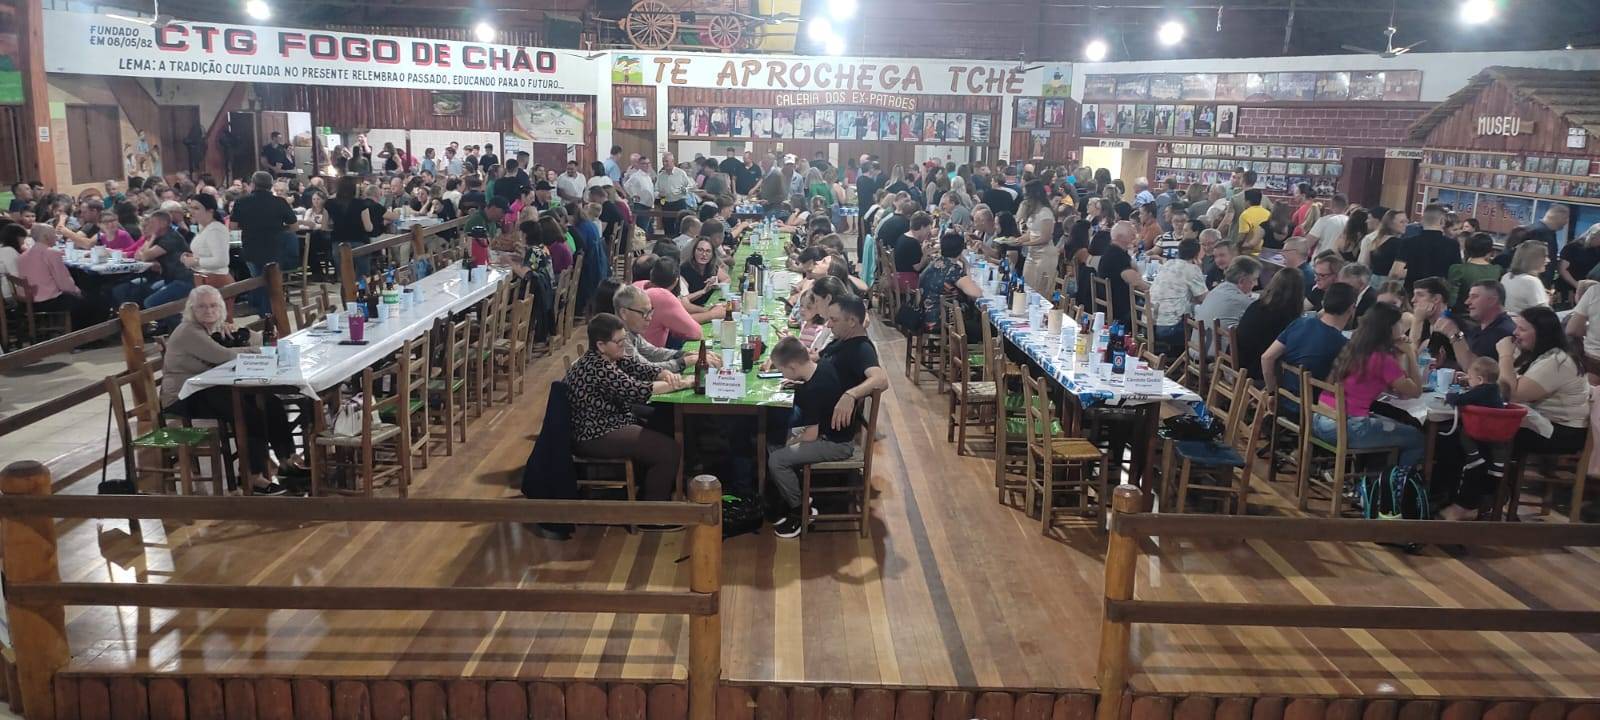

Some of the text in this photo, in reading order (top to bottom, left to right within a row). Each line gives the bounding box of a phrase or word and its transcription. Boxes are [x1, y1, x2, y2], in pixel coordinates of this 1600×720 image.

[90, 25, 139, 37] FUNDADO
[90, 35, 153, 49] EM 08/05/82
[154, 24, 557, 74] CTG FOGO DE CHÃO
[118, 58, 156, 71] LEMA:
[159, 60, 167, 71] A
[171, 59, 222, 75] TRADIÇÃO
[225, 63, 281, 77] CULTUADA
[284, 66, 299, 77] NO
[302, 67, 349, 80] PRESENTE
[453, 74, 496, 87] EDUCANDO
[498, 77, 518, 88] PARA
[653, 56, 692, 85] TE
[716, 60, 924, 92] APROCHEGA
[825, 91, 847, 104] DOS
[1477, 116, 1521, 137] MUSEU
